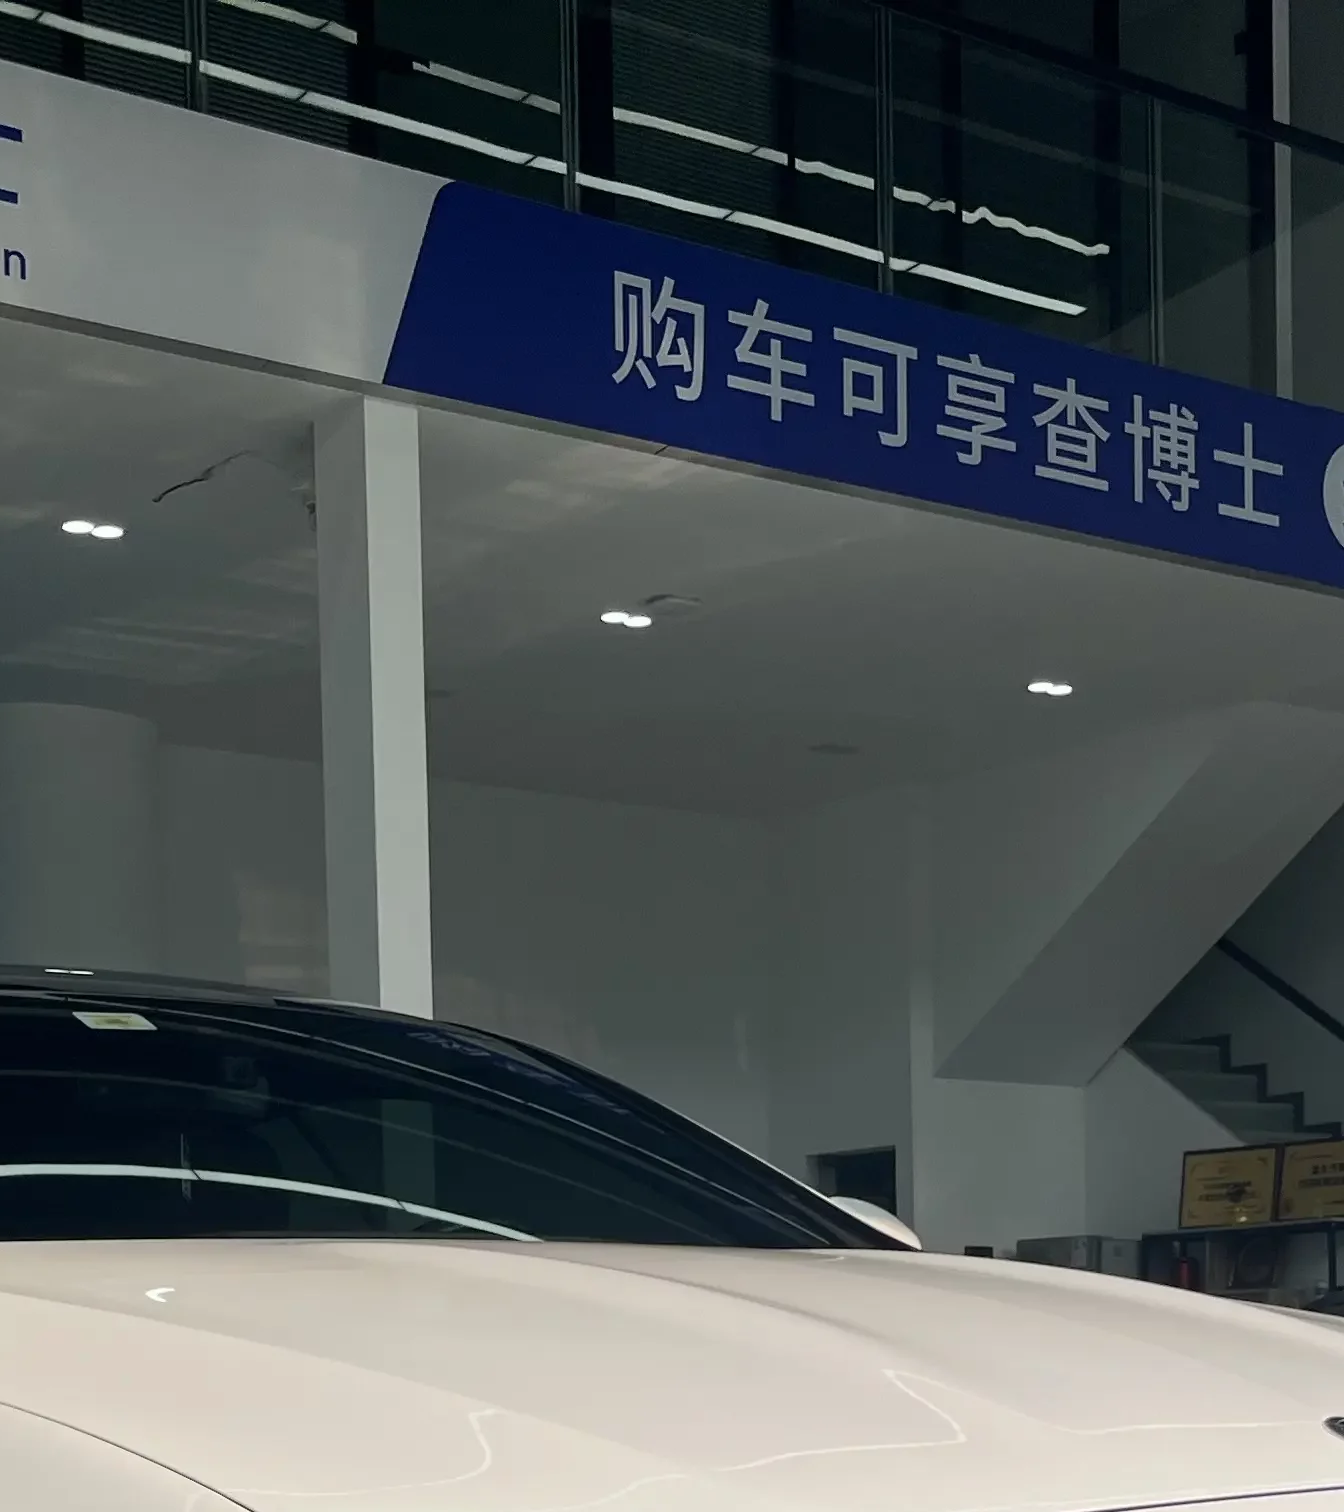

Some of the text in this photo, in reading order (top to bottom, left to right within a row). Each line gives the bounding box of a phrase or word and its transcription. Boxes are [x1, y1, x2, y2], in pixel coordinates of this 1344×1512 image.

[611, 268, 1285, 528] 购车可享查博士
